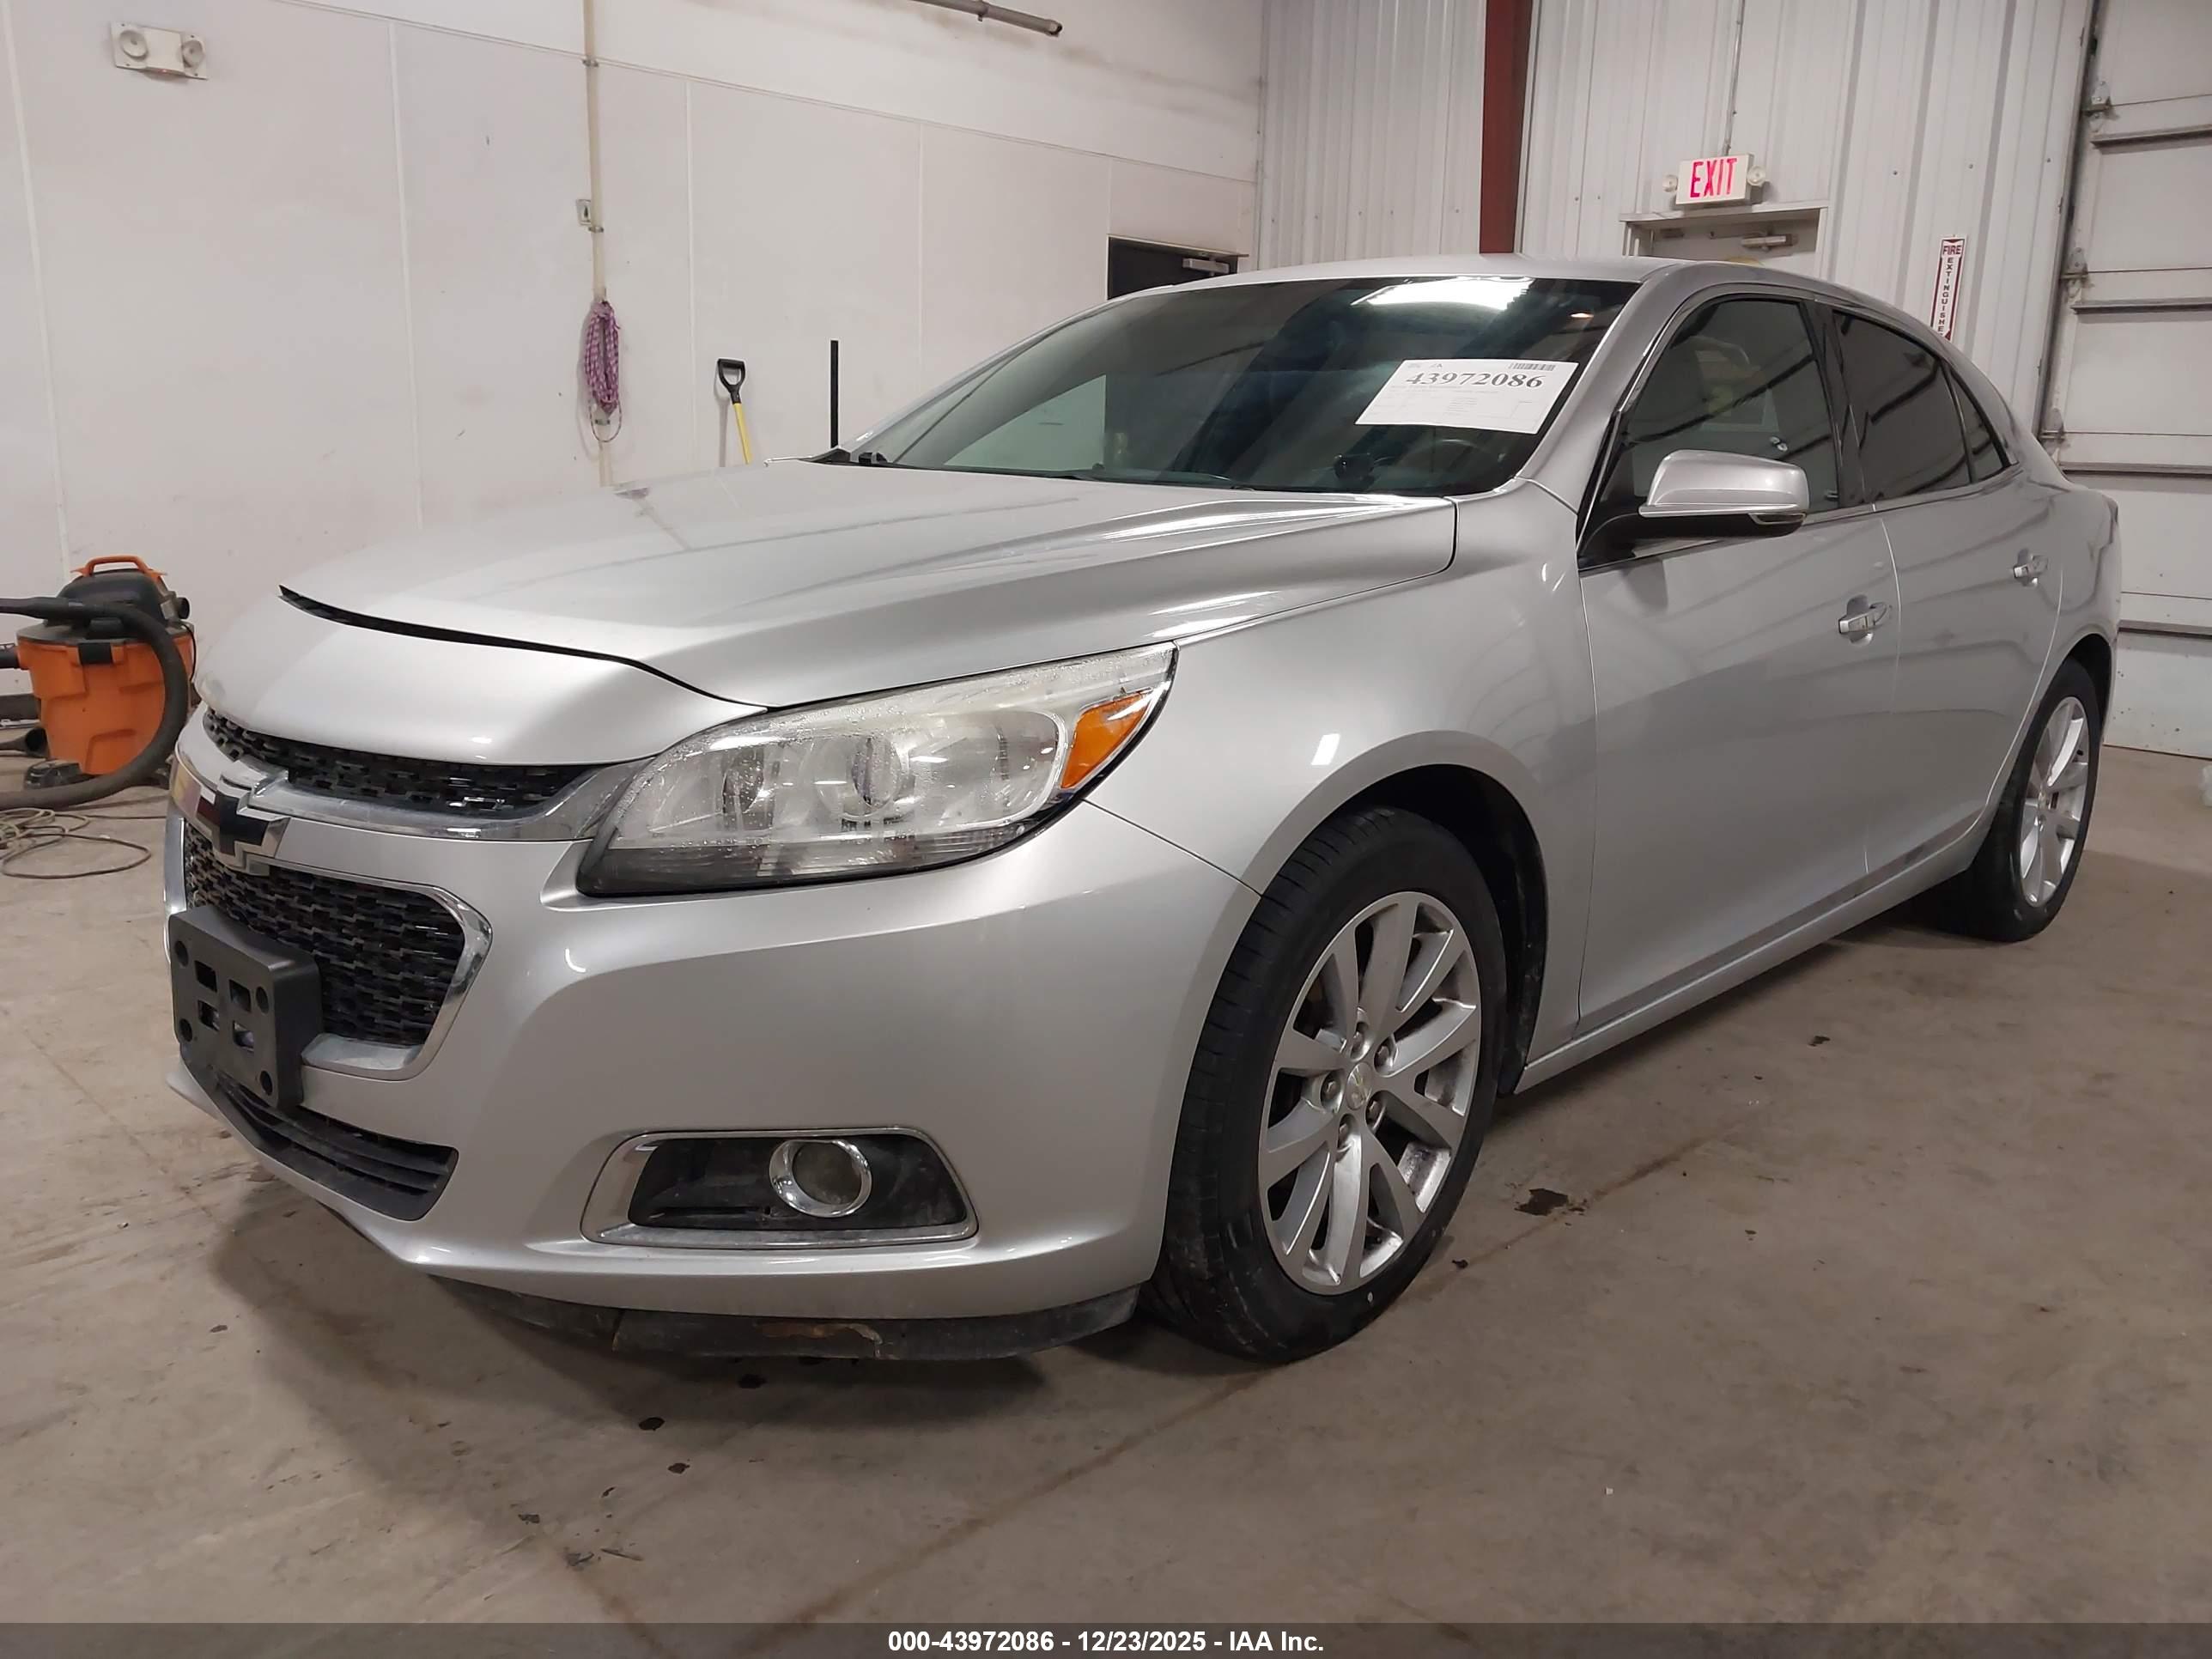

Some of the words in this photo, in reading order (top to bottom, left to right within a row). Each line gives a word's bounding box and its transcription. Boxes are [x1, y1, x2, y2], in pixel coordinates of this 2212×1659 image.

[1690, 158, 1738, 198] EXIT
[1942, 245, 1962, 255] FIRE
[1937, 257, 1954, 336] EXTINGUISHE
[1406, 372, 1547, 388] 43972086
